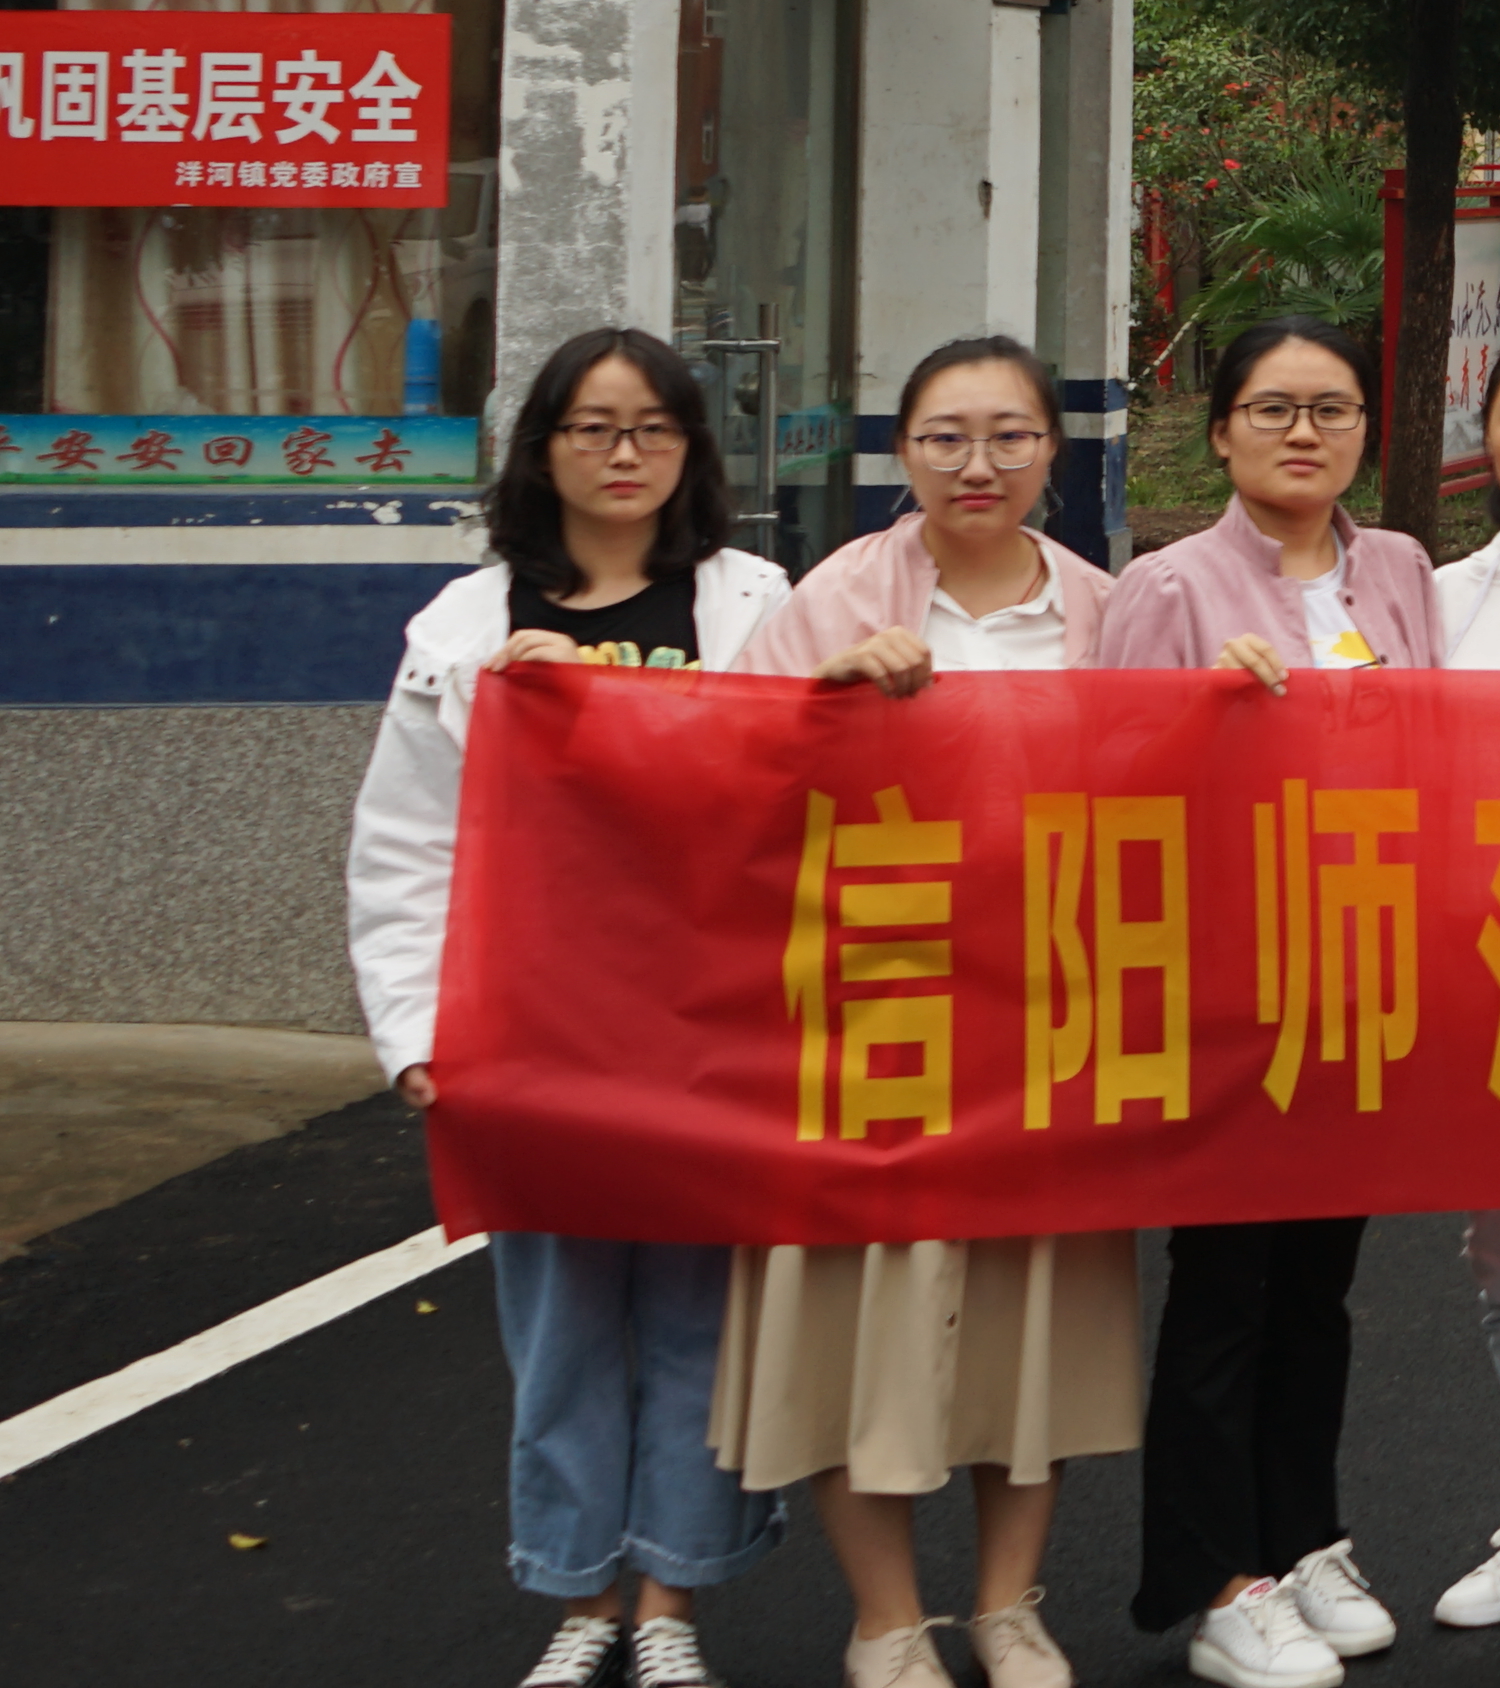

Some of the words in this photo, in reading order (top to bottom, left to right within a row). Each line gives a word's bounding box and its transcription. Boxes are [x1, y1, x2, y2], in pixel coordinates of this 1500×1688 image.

[176, 161, 421, 188] 洋河镇党委政府宣
